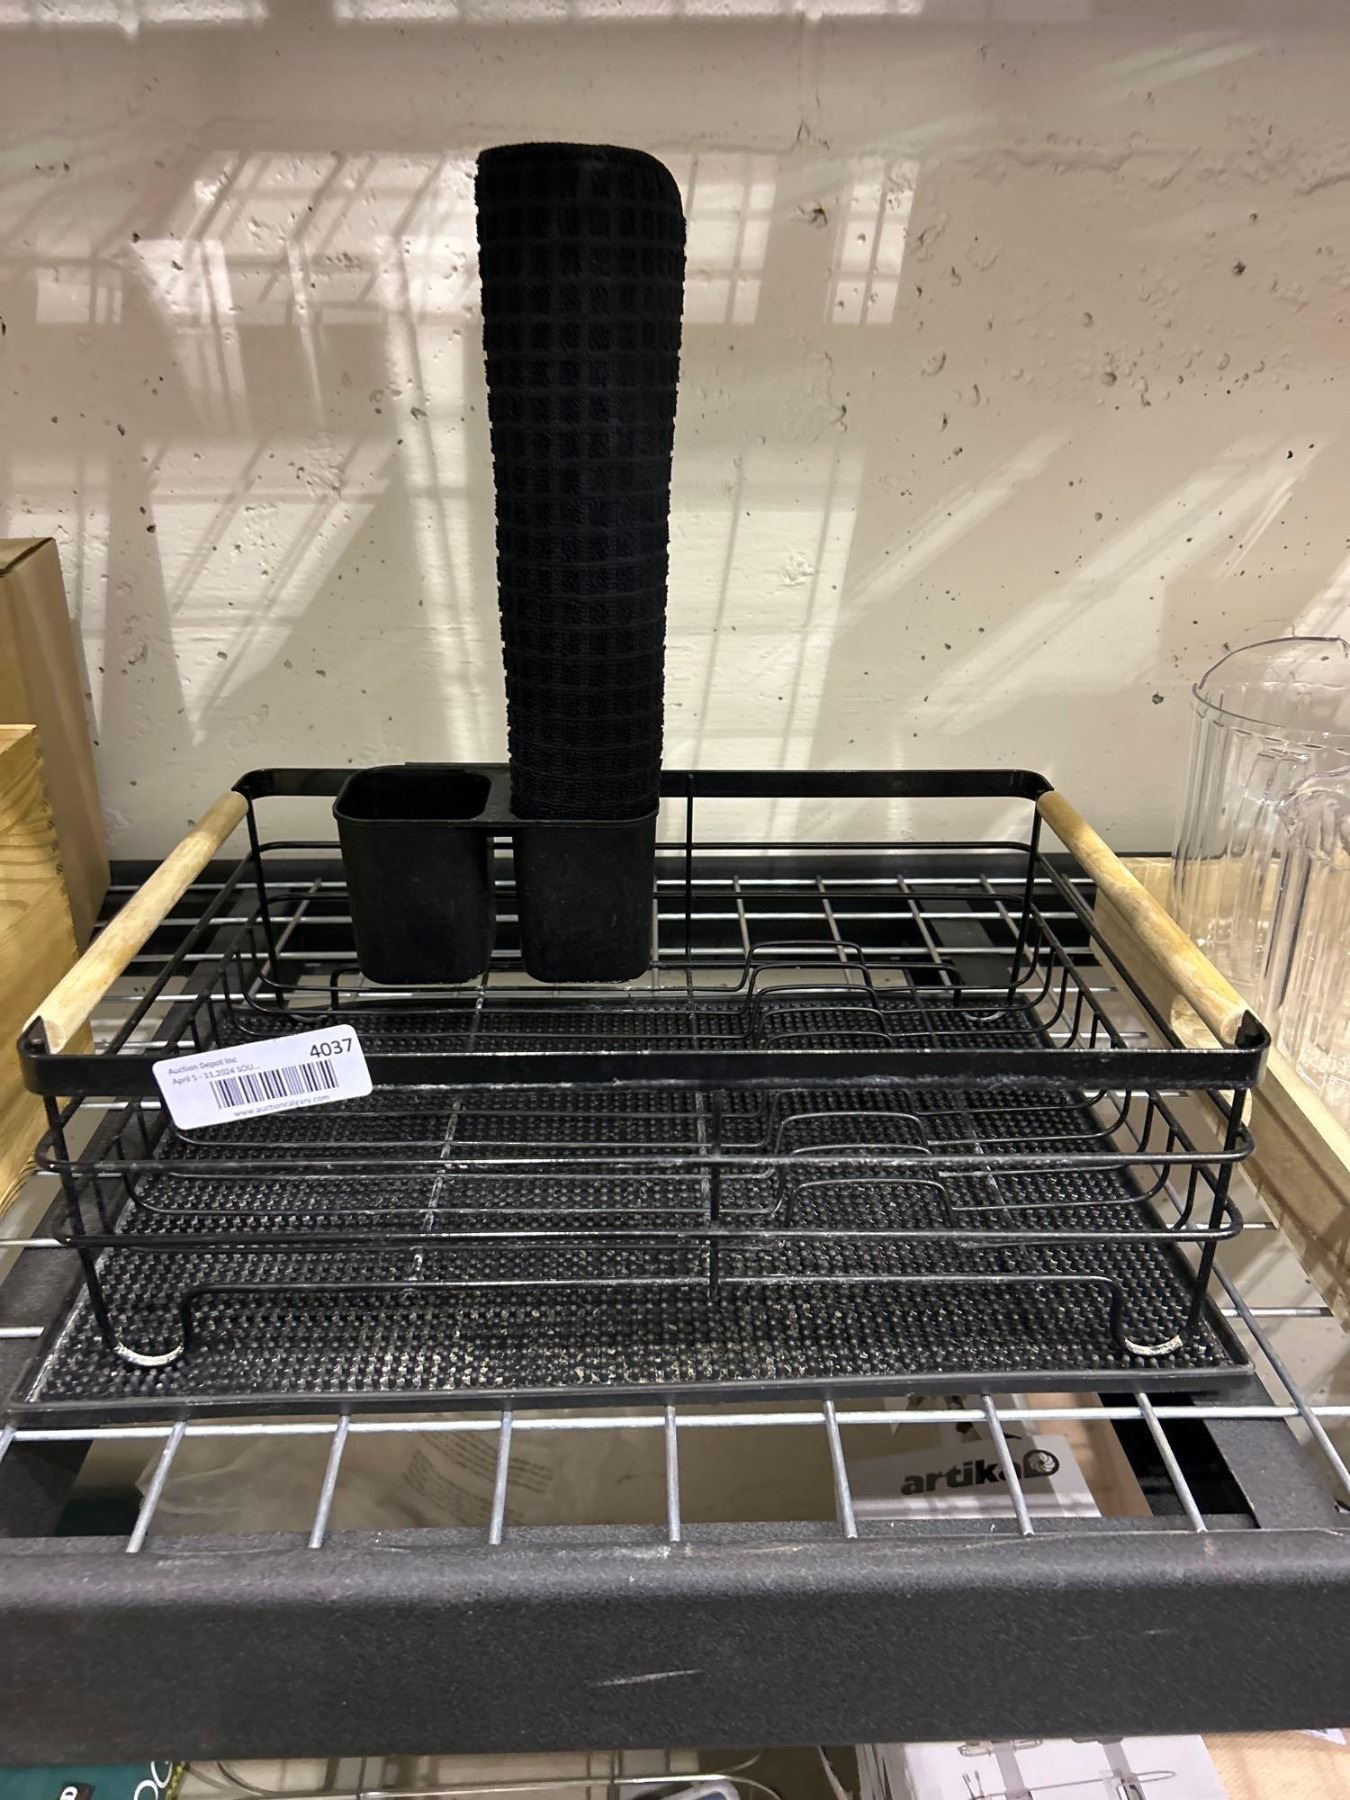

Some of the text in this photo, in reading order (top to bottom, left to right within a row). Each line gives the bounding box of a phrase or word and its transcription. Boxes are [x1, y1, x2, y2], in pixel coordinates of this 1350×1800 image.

[309, 1037, 353, 1058] 4037
[168, 1063, 199, 1075] Auction
[172, 1075, 191, 1086] April
